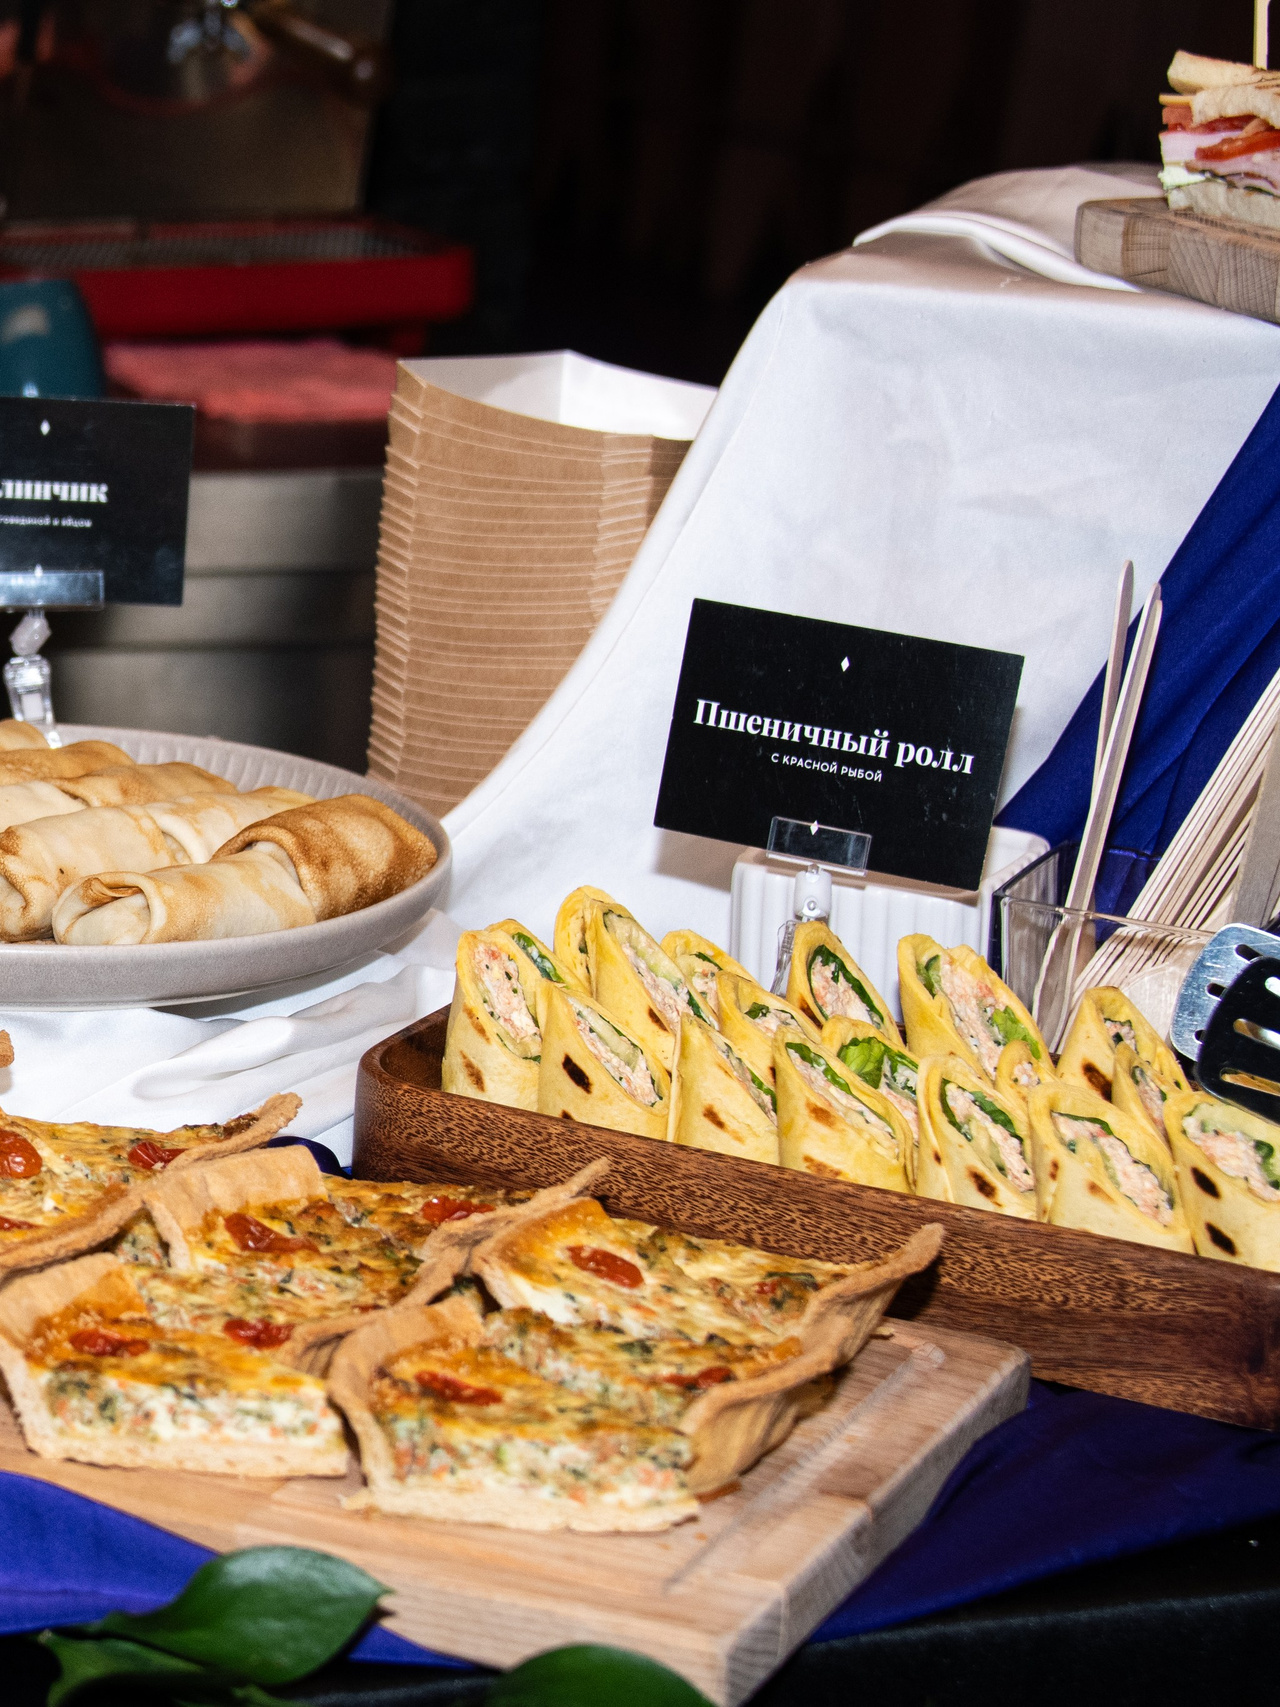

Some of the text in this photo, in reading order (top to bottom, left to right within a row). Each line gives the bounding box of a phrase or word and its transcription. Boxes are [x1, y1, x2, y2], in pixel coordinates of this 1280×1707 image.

[693, 699, 975, 774] Пшеничный ролл
[771, 753, 883, 783] С КРАСНОЙ РЫБОЙ
